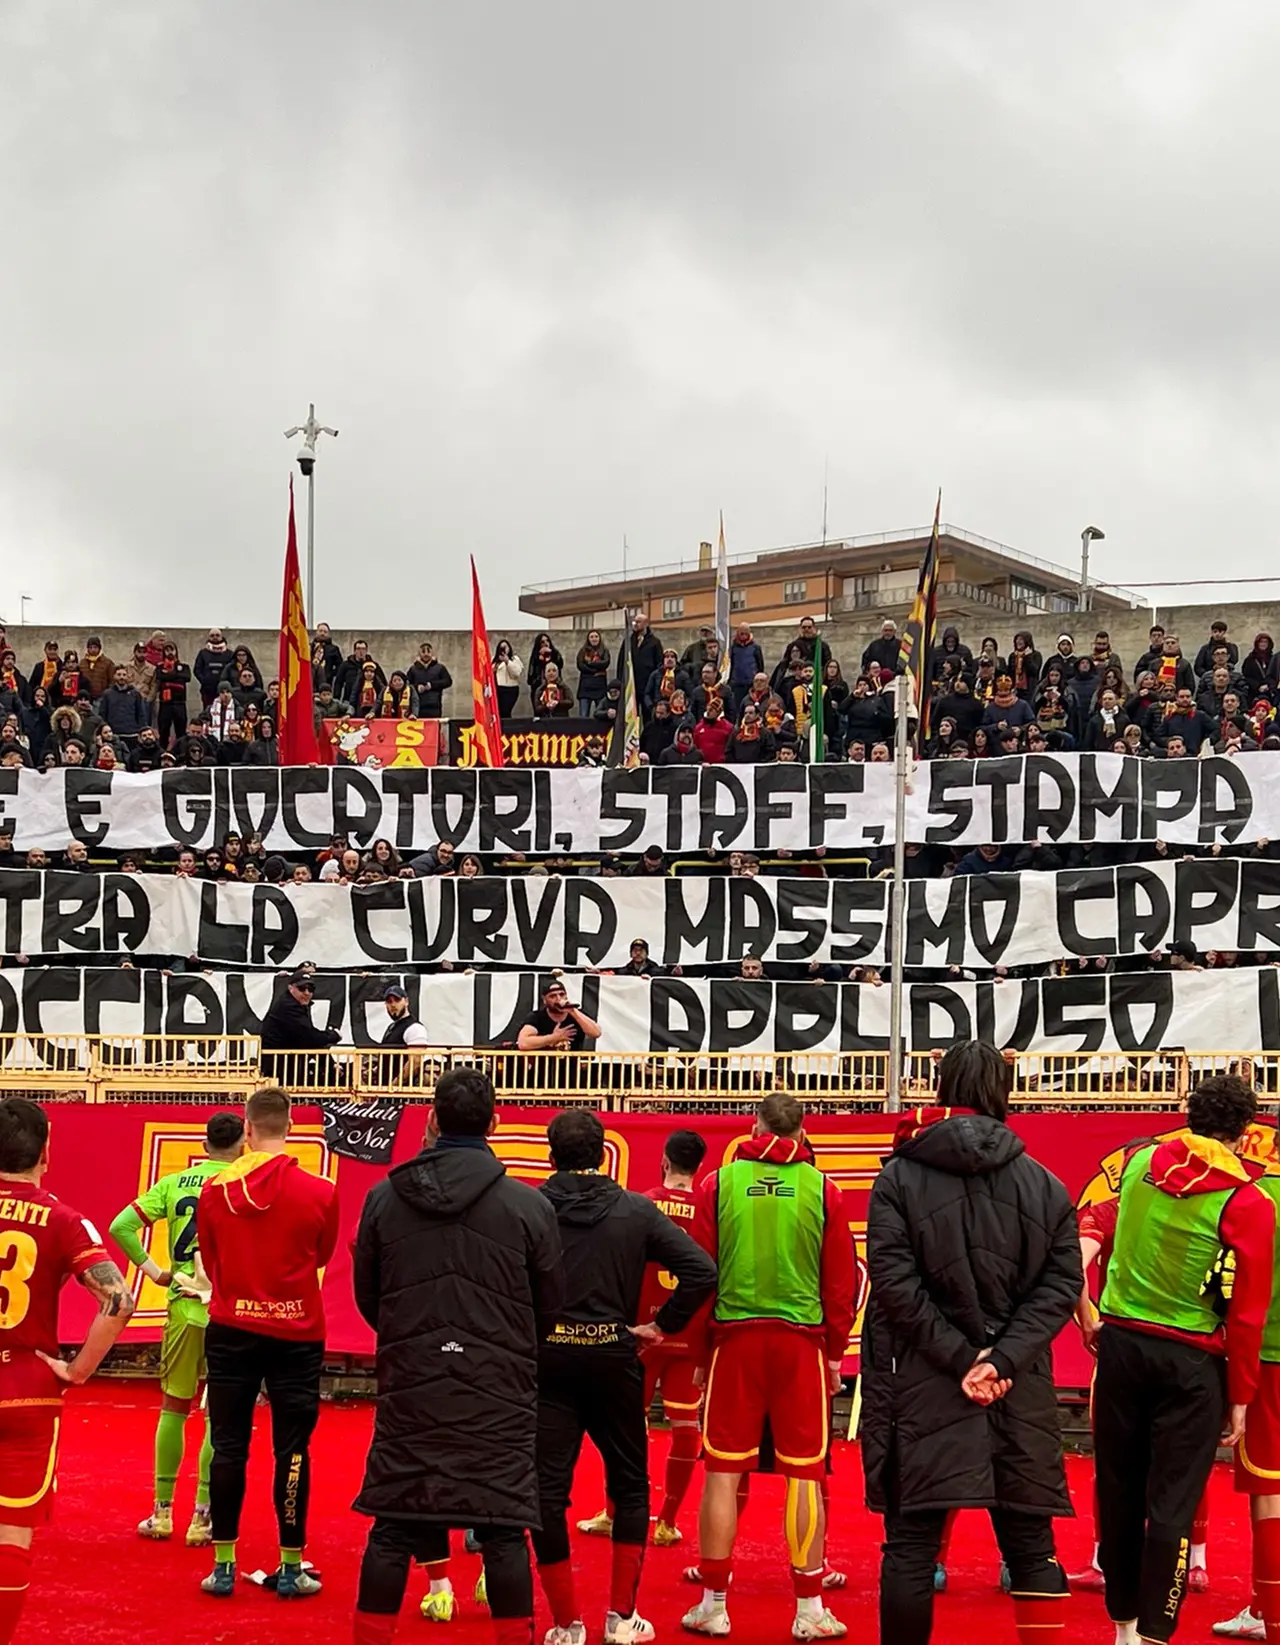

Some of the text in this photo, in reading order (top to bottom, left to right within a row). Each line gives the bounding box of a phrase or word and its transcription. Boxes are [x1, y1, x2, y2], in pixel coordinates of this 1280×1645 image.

[65, 768, 114, 848] E
[925, 753, 1253, 845] STAMPA
[197, 882, 300, 965] LA
[351, 876, 618, 966] CURVA
[663, 874, 1021, 966] MASSIMO
[649, 971, 1174, 1075] APPLAUSO
[283, 1453, 303, 1527] EYESPORT
